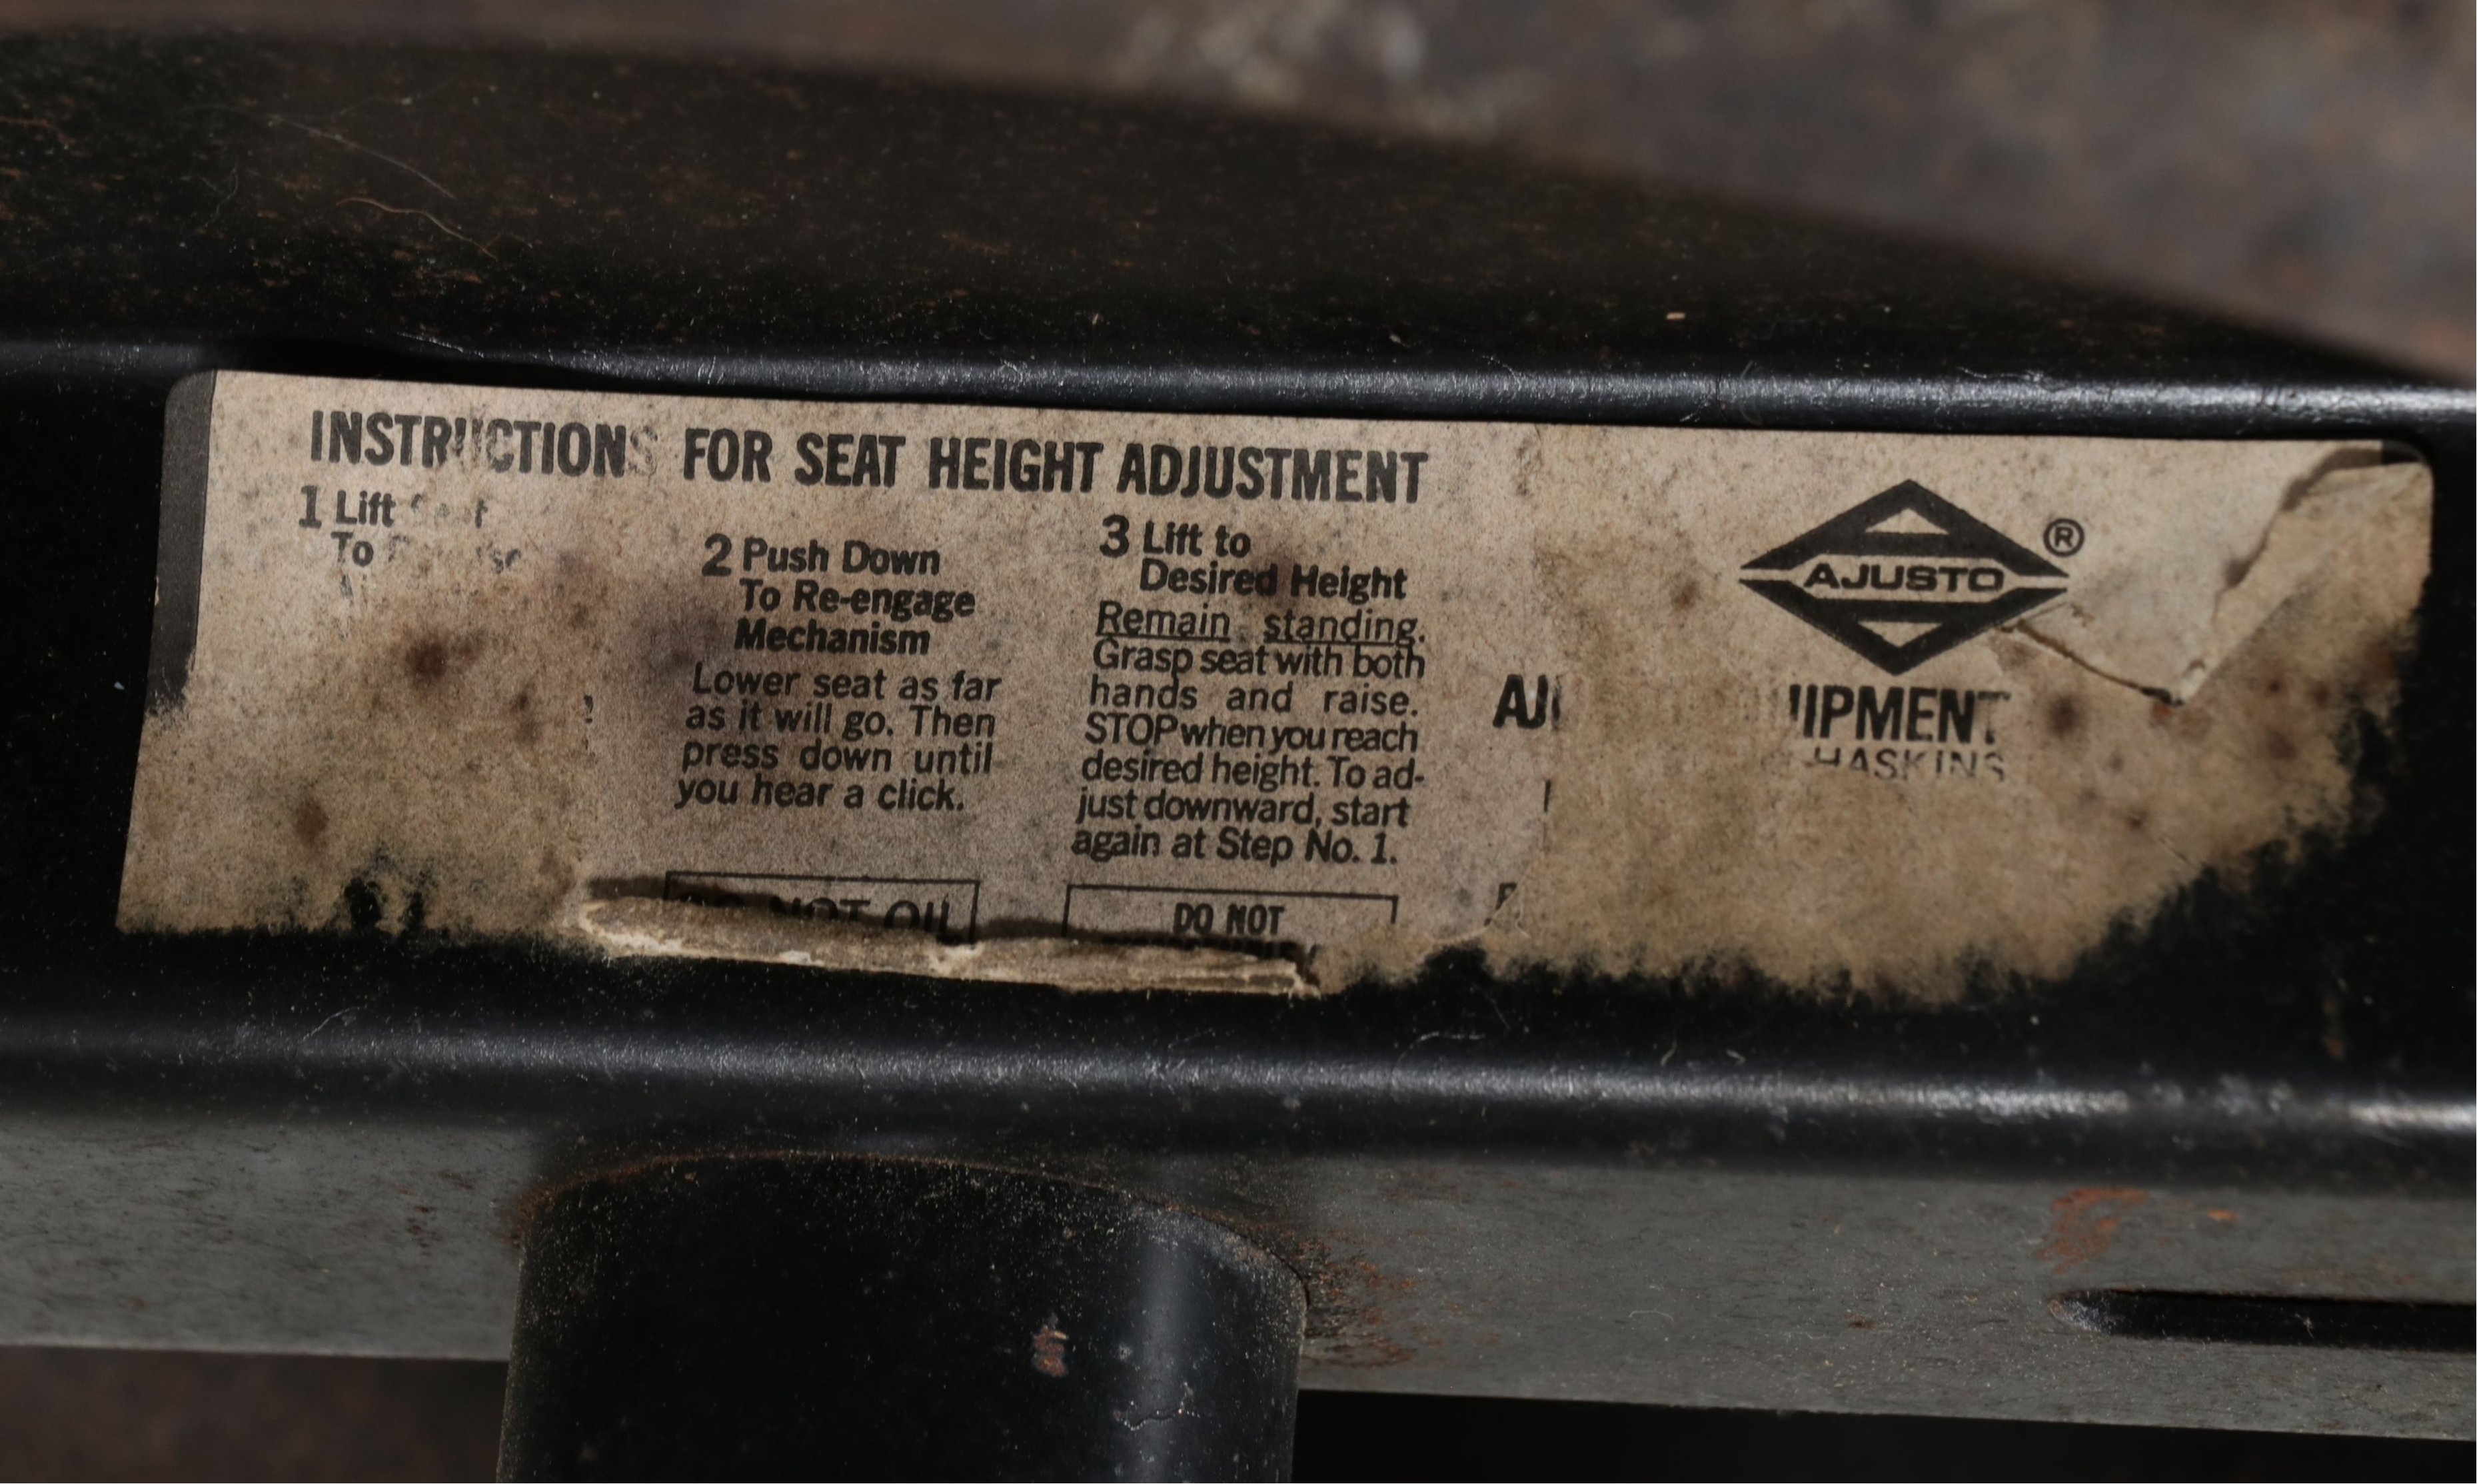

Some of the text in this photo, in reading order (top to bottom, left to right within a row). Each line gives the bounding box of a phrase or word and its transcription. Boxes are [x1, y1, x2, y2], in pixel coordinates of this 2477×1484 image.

[683, 427, 773, 483] FOR
[793, 432, 906, 487] SEAT
[928, 436, 1104, 494] HEIGHT
[1117, 442, 1429, 504] ADJUSTMENT
[299, 485, 322, 528] 1
[335, 490, 396, 527] Lift
[331, 531, 374, 567] To
[702, 533, 940, 576] 2 Push Down
[1099, 514, 1251, 558] 3 Lift to
[1140, 558, 1407, 604] Desired Height
[1803, 562, 2005, 592] AJUSTO
[739, 578, 976, 622] To Re-engage
[734, 618, 930, 655] Mechanism
[1097, 600, 1425, 646] Remain standing.
[1093, 639, 1425, 680] Grasp seat with both
[692, 662, 1002, 702] Lower seat as far
[1089, 674, 1418, 716] hands and raise.
[686, 699, 996, 742] as it will go. Then
[1085, 712, 1418, 755] STOP when you reach
[682, 738, 993, 774] press down until
[1082, 749, 1425, 793] desired height. To ad-
[674, 774, 964, 811] you hear a click.
[1076, 786, 1409, 828] just downward, start
[1071, 824, 1397, 867] again at Step No. 1.
[1174, 902, 1285, 934] DO NOT
